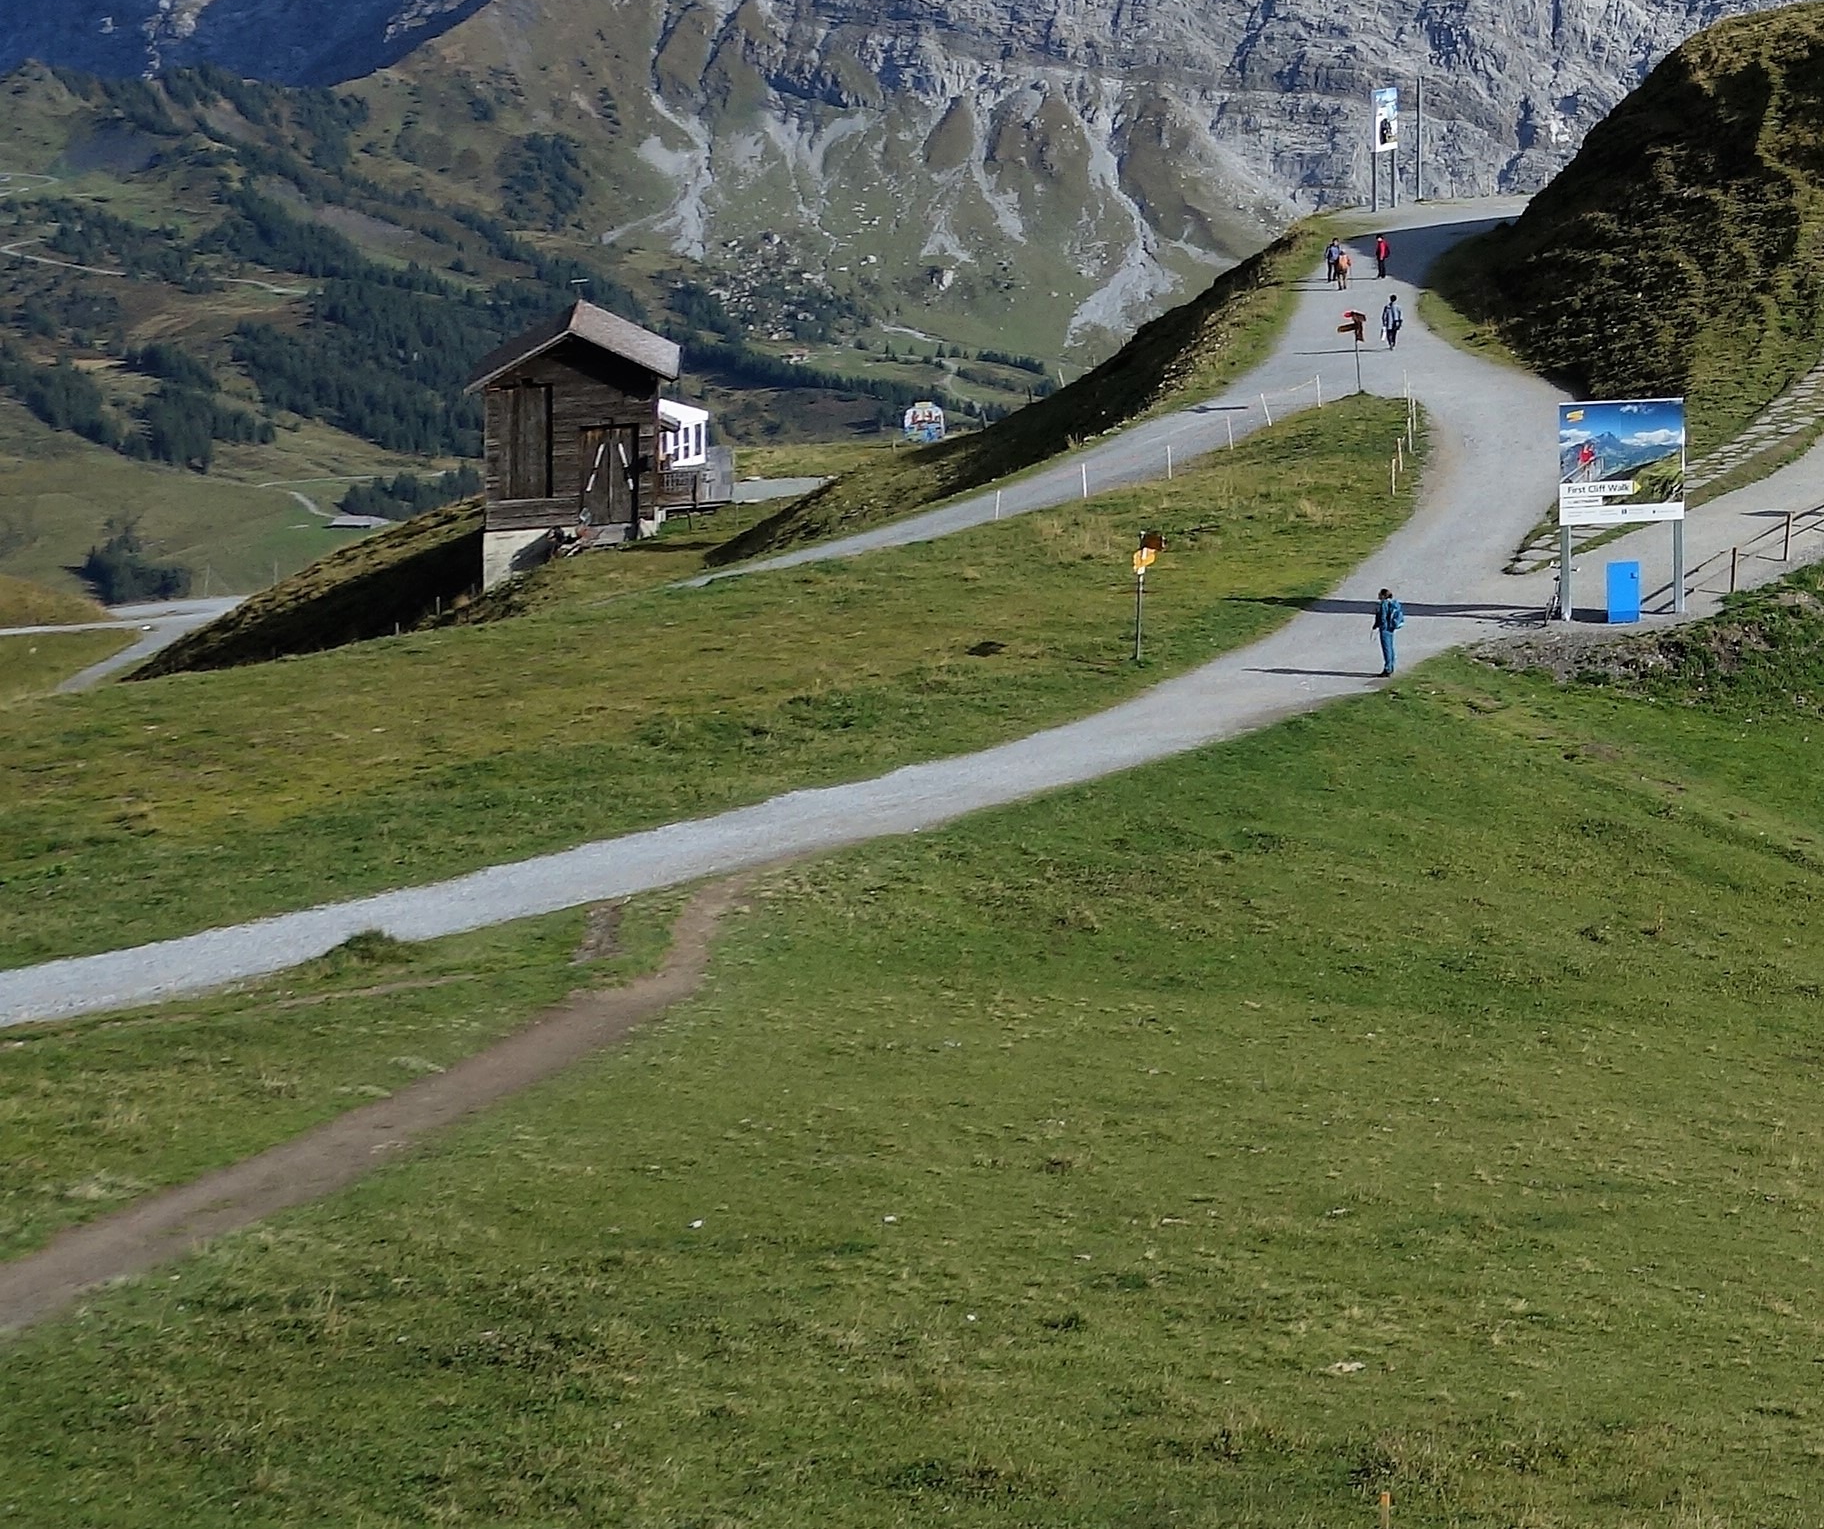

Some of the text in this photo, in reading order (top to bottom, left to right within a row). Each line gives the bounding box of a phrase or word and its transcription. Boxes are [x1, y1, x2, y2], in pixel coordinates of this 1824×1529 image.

[1567, 484, 1629, 494] First Cliff Walk
